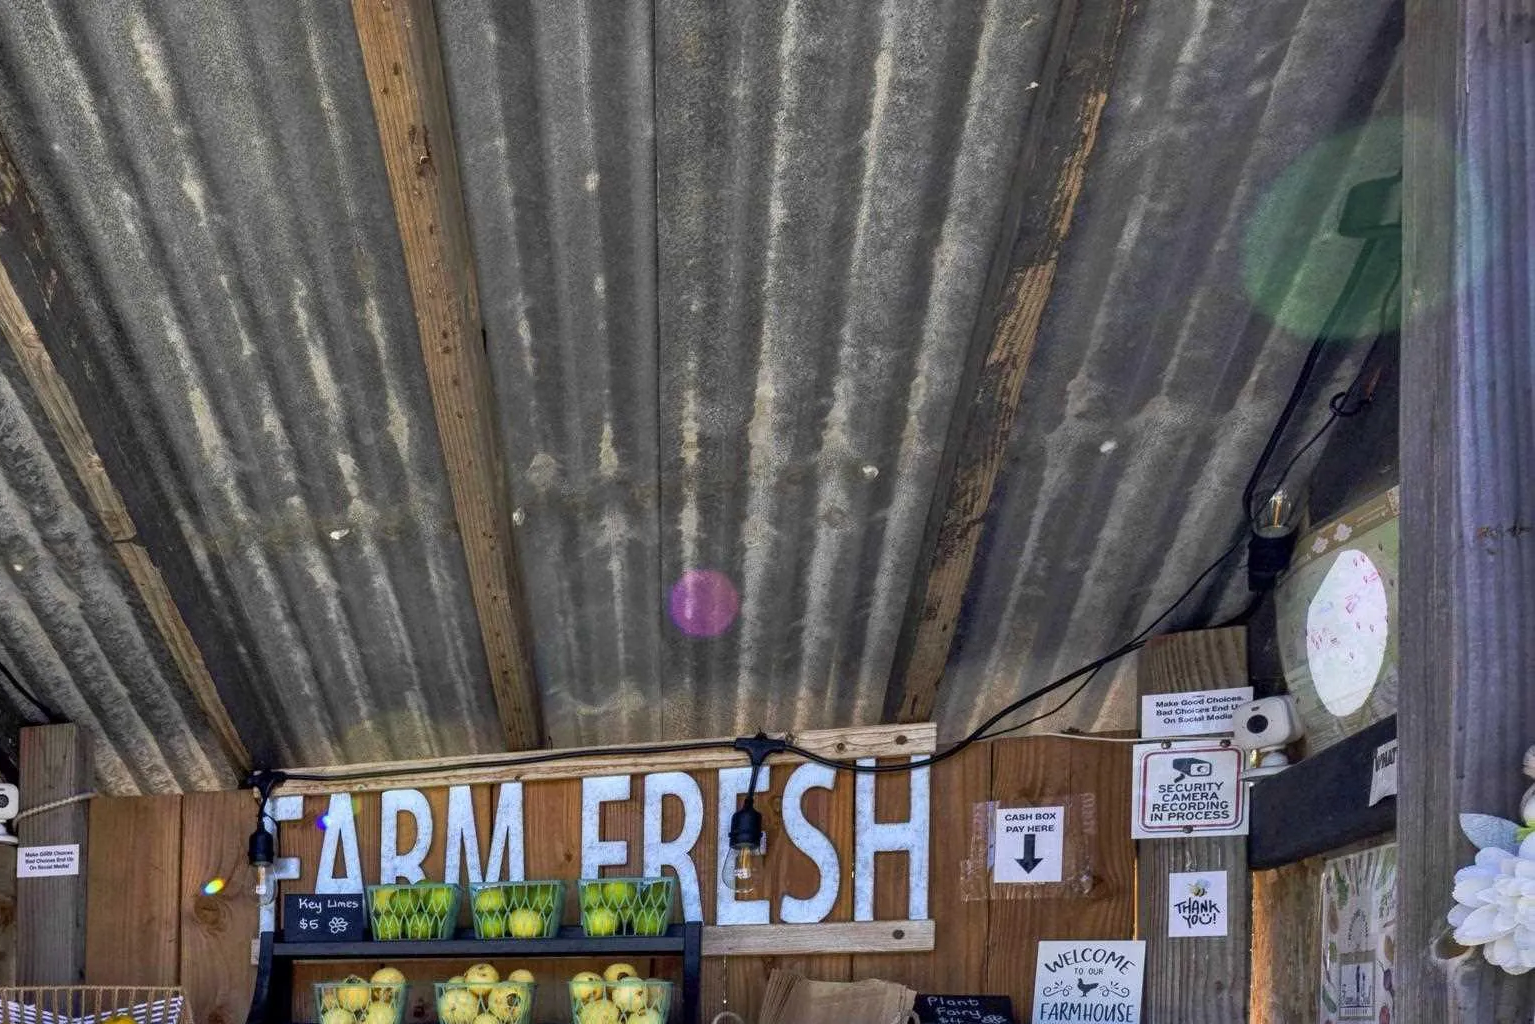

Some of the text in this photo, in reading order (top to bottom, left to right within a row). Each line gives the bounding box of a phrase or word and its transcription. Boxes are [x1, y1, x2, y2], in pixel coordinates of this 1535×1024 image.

[1181, 698, 1205, 706] Good
[1175, 707, 1210, 715] Choices
[1212, 703, 1229, 712] End
[1178, 715, 1204, 723] Social
[1158, 781, 1224, 793] SECURITY
[1162, 792, 1219, 802] CAMERA
[1152, 800, 1229, 812] RECORDING
[1005, 812, 1056, 821] CASH BOX
[1150, 810, 1230, 822] IN PROCESS
[259, 754, 931, 932] FARM FRESH
[298, 898, 322, 914] Key
[1174, 897, 1221, 914] THANK
[299, 918, 319, 930] $5
[1044, 947, 1136, 975] WELCOME
[1074, 967, 1104, 976] TO OUR
[927, 996, 979, 1006] Plant
[936, 1006, 982, 1019] Fairy
[1040, 1001, 1135, 1023] FARMHOUSE
